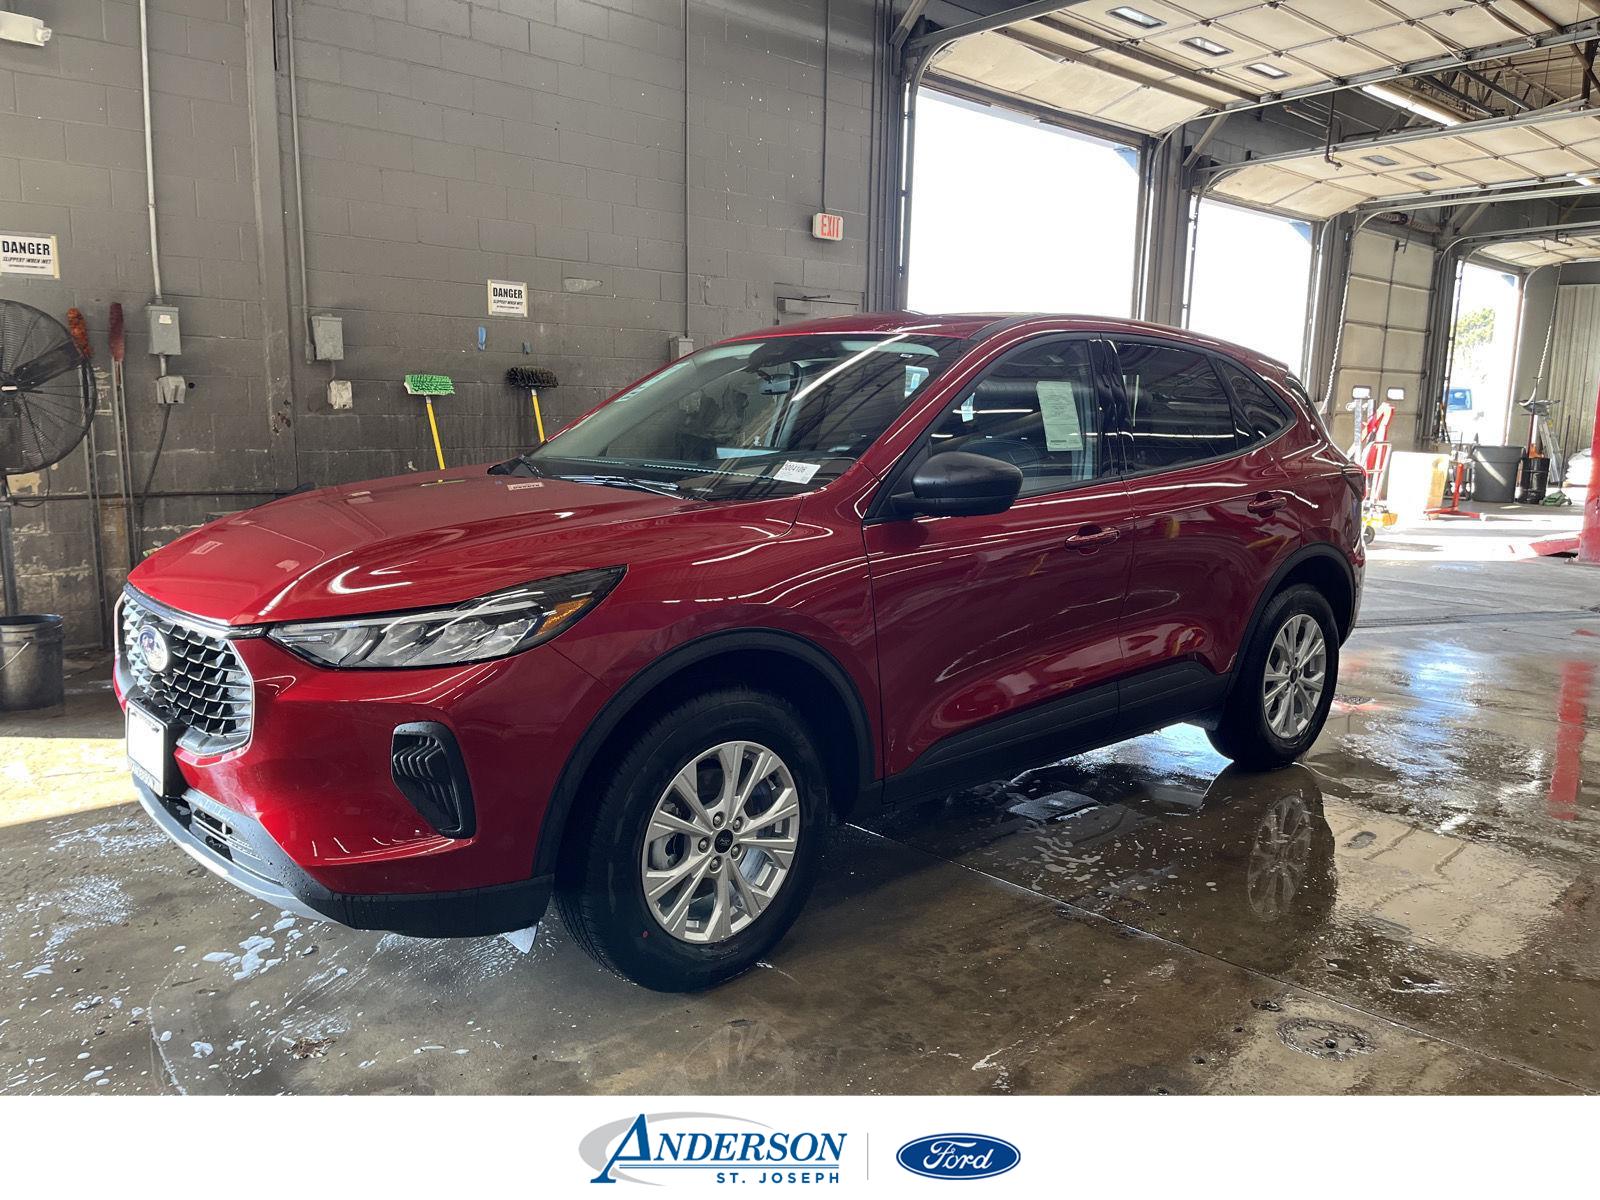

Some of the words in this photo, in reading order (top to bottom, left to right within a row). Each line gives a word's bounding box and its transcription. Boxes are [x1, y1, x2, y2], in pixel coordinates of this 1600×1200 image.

[821, 214, 841, 238] EXIT
[2, 241, 50, 255] DANGER
[493, 287, 523, 298] DANGER
